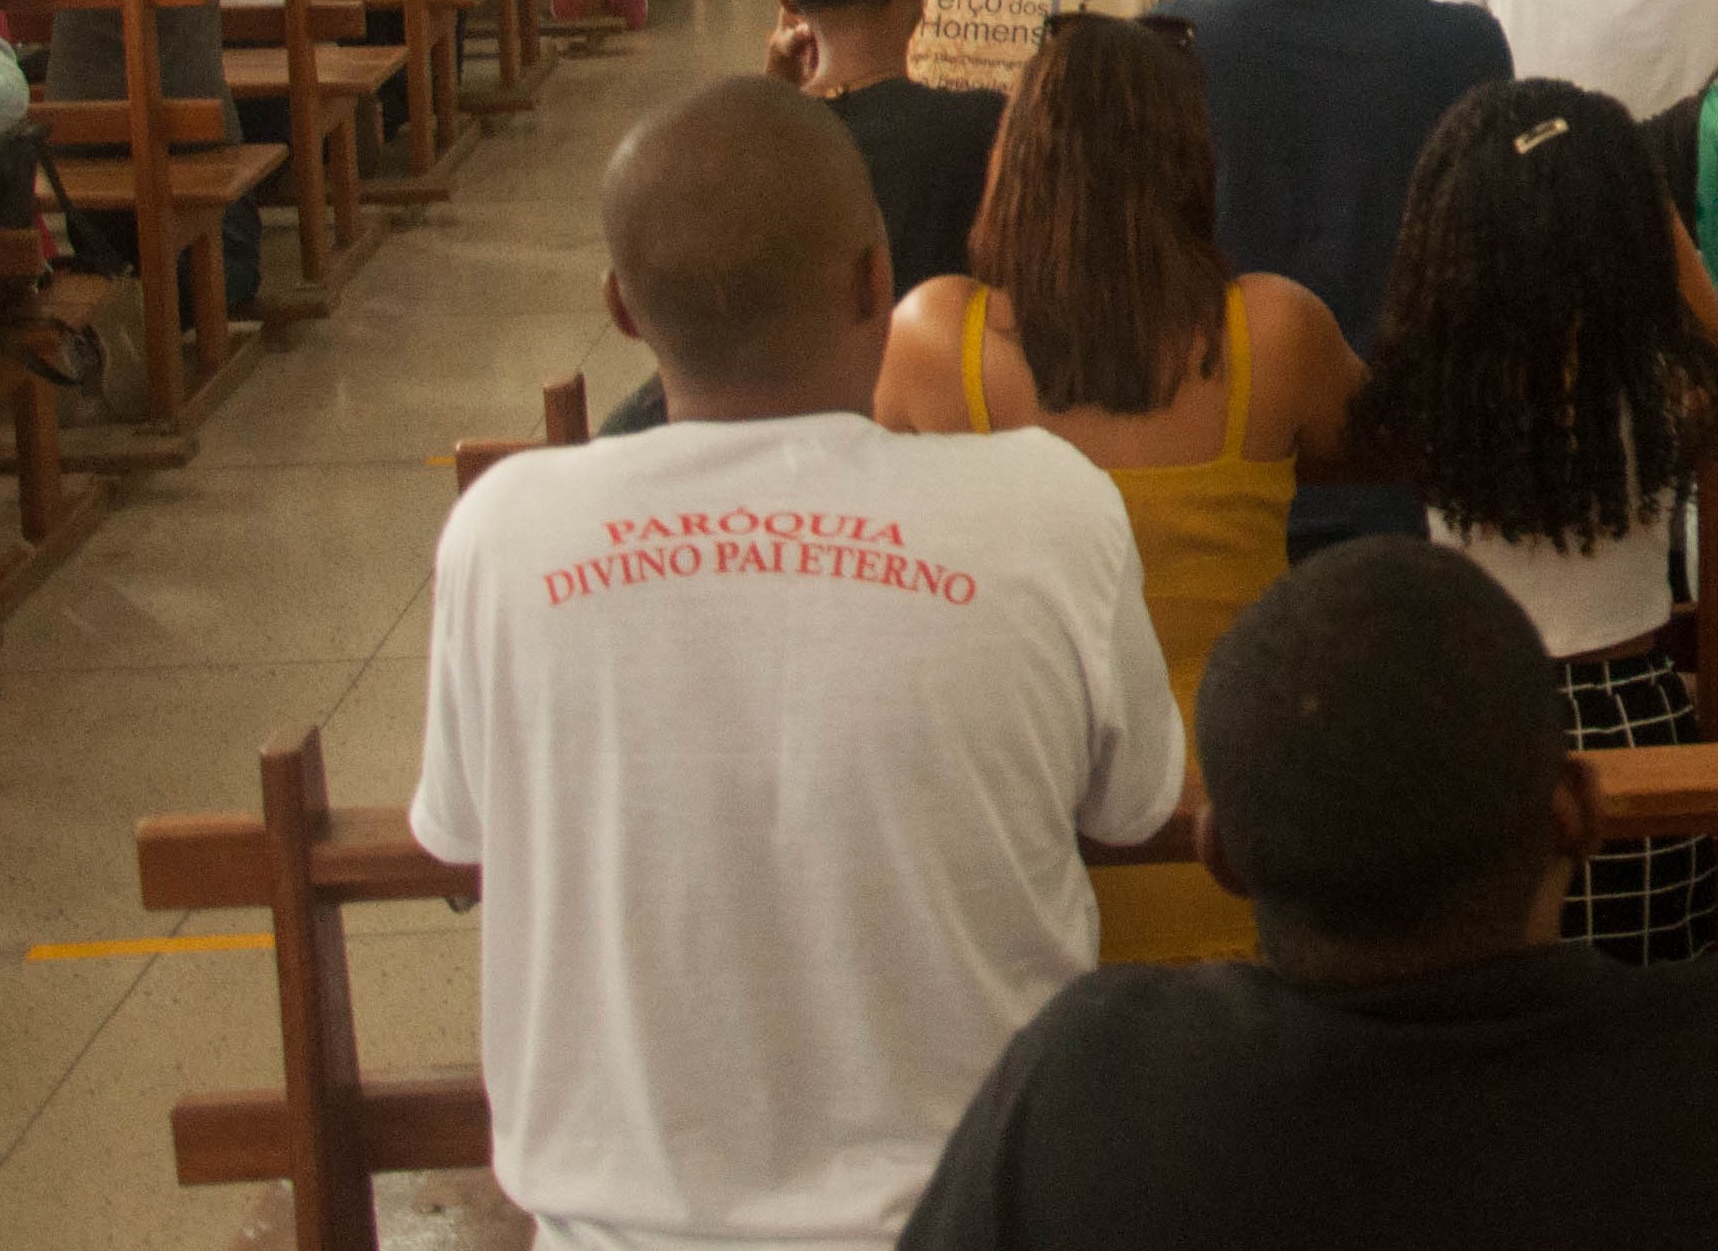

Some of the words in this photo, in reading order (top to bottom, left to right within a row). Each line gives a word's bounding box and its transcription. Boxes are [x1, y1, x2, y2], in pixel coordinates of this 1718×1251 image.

[920, 14, 1045, 45] Homens
[543, 543, 702, 607] DIVINO
[714, 540, 785, 575] PAI
[795, 542, 977, 607] ETERNO
